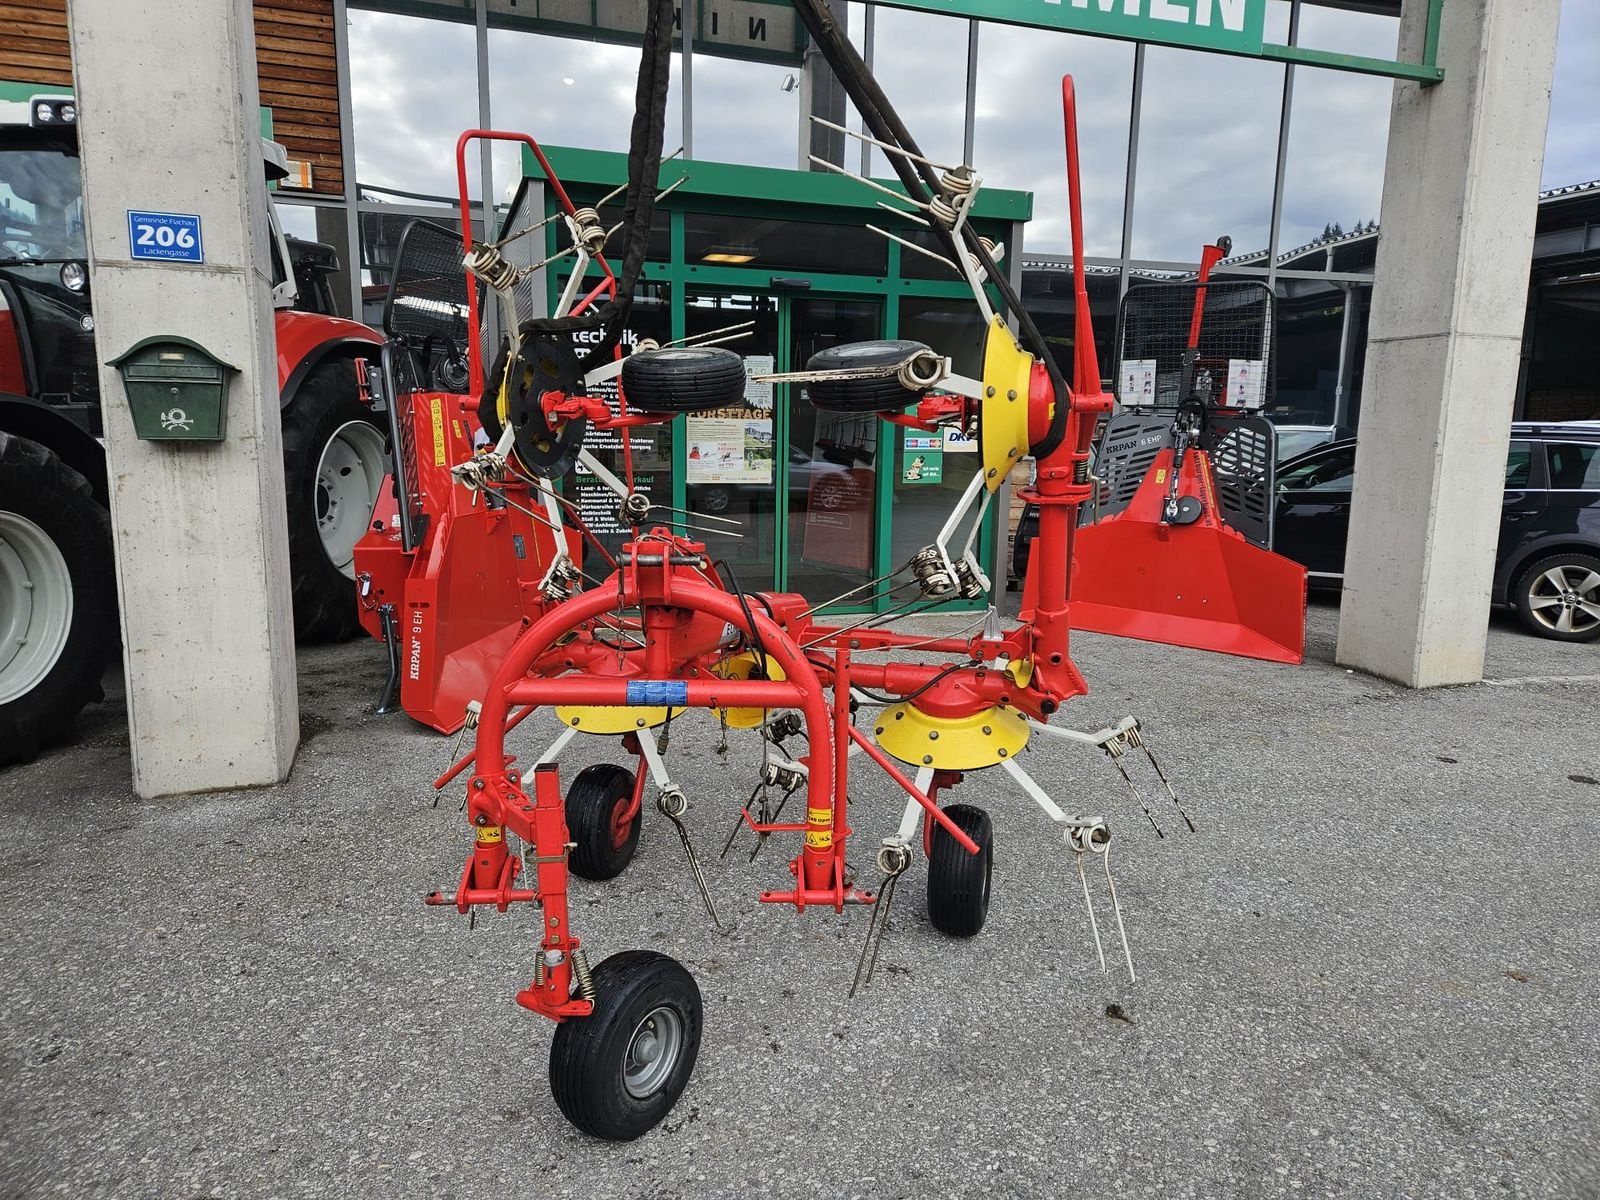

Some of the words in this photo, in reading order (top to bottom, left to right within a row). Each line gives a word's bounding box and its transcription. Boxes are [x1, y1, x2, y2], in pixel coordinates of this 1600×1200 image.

[133, 215, 168, 225] Gemeinde
[170, 218, 195, 227] Flachau
[137, 224, 195, 249] 206
[143, 247, 190, 257] Lackengasse
[572, 327, 639, 345] techik
[1105, 440, 1137, 454] KRPAN
[1147, 434, 1162, 444] EHP
[413, 610, 423, 625] EH
[412, 626, 422, 634] 9
[410, 638, 421, 680] KRPAN
